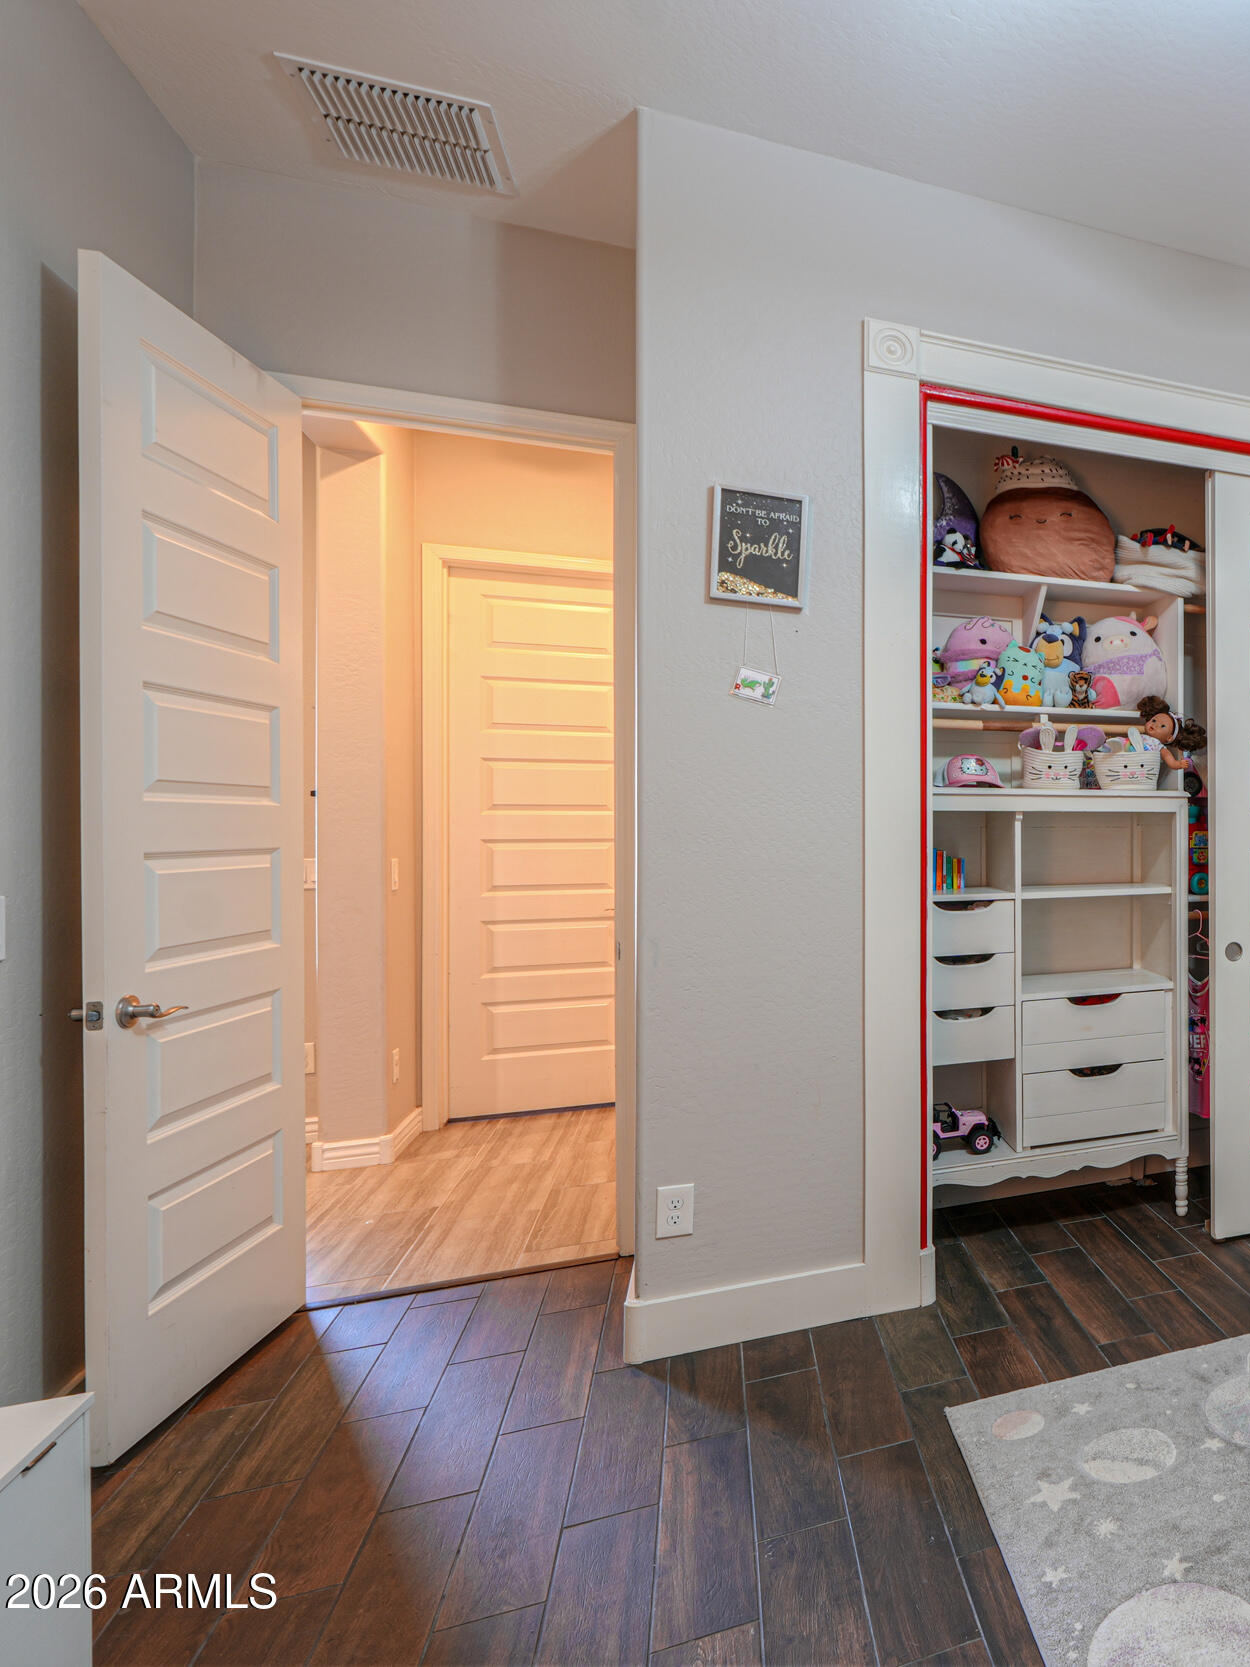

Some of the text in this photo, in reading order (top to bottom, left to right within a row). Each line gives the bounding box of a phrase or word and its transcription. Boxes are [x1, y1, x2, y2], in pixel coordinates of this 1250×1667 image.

[726, 504, 799, 522] DON'T BE AFRAID
[758, 518, 769, 526] TO
[728, 528, 793, 568] Sparkle
